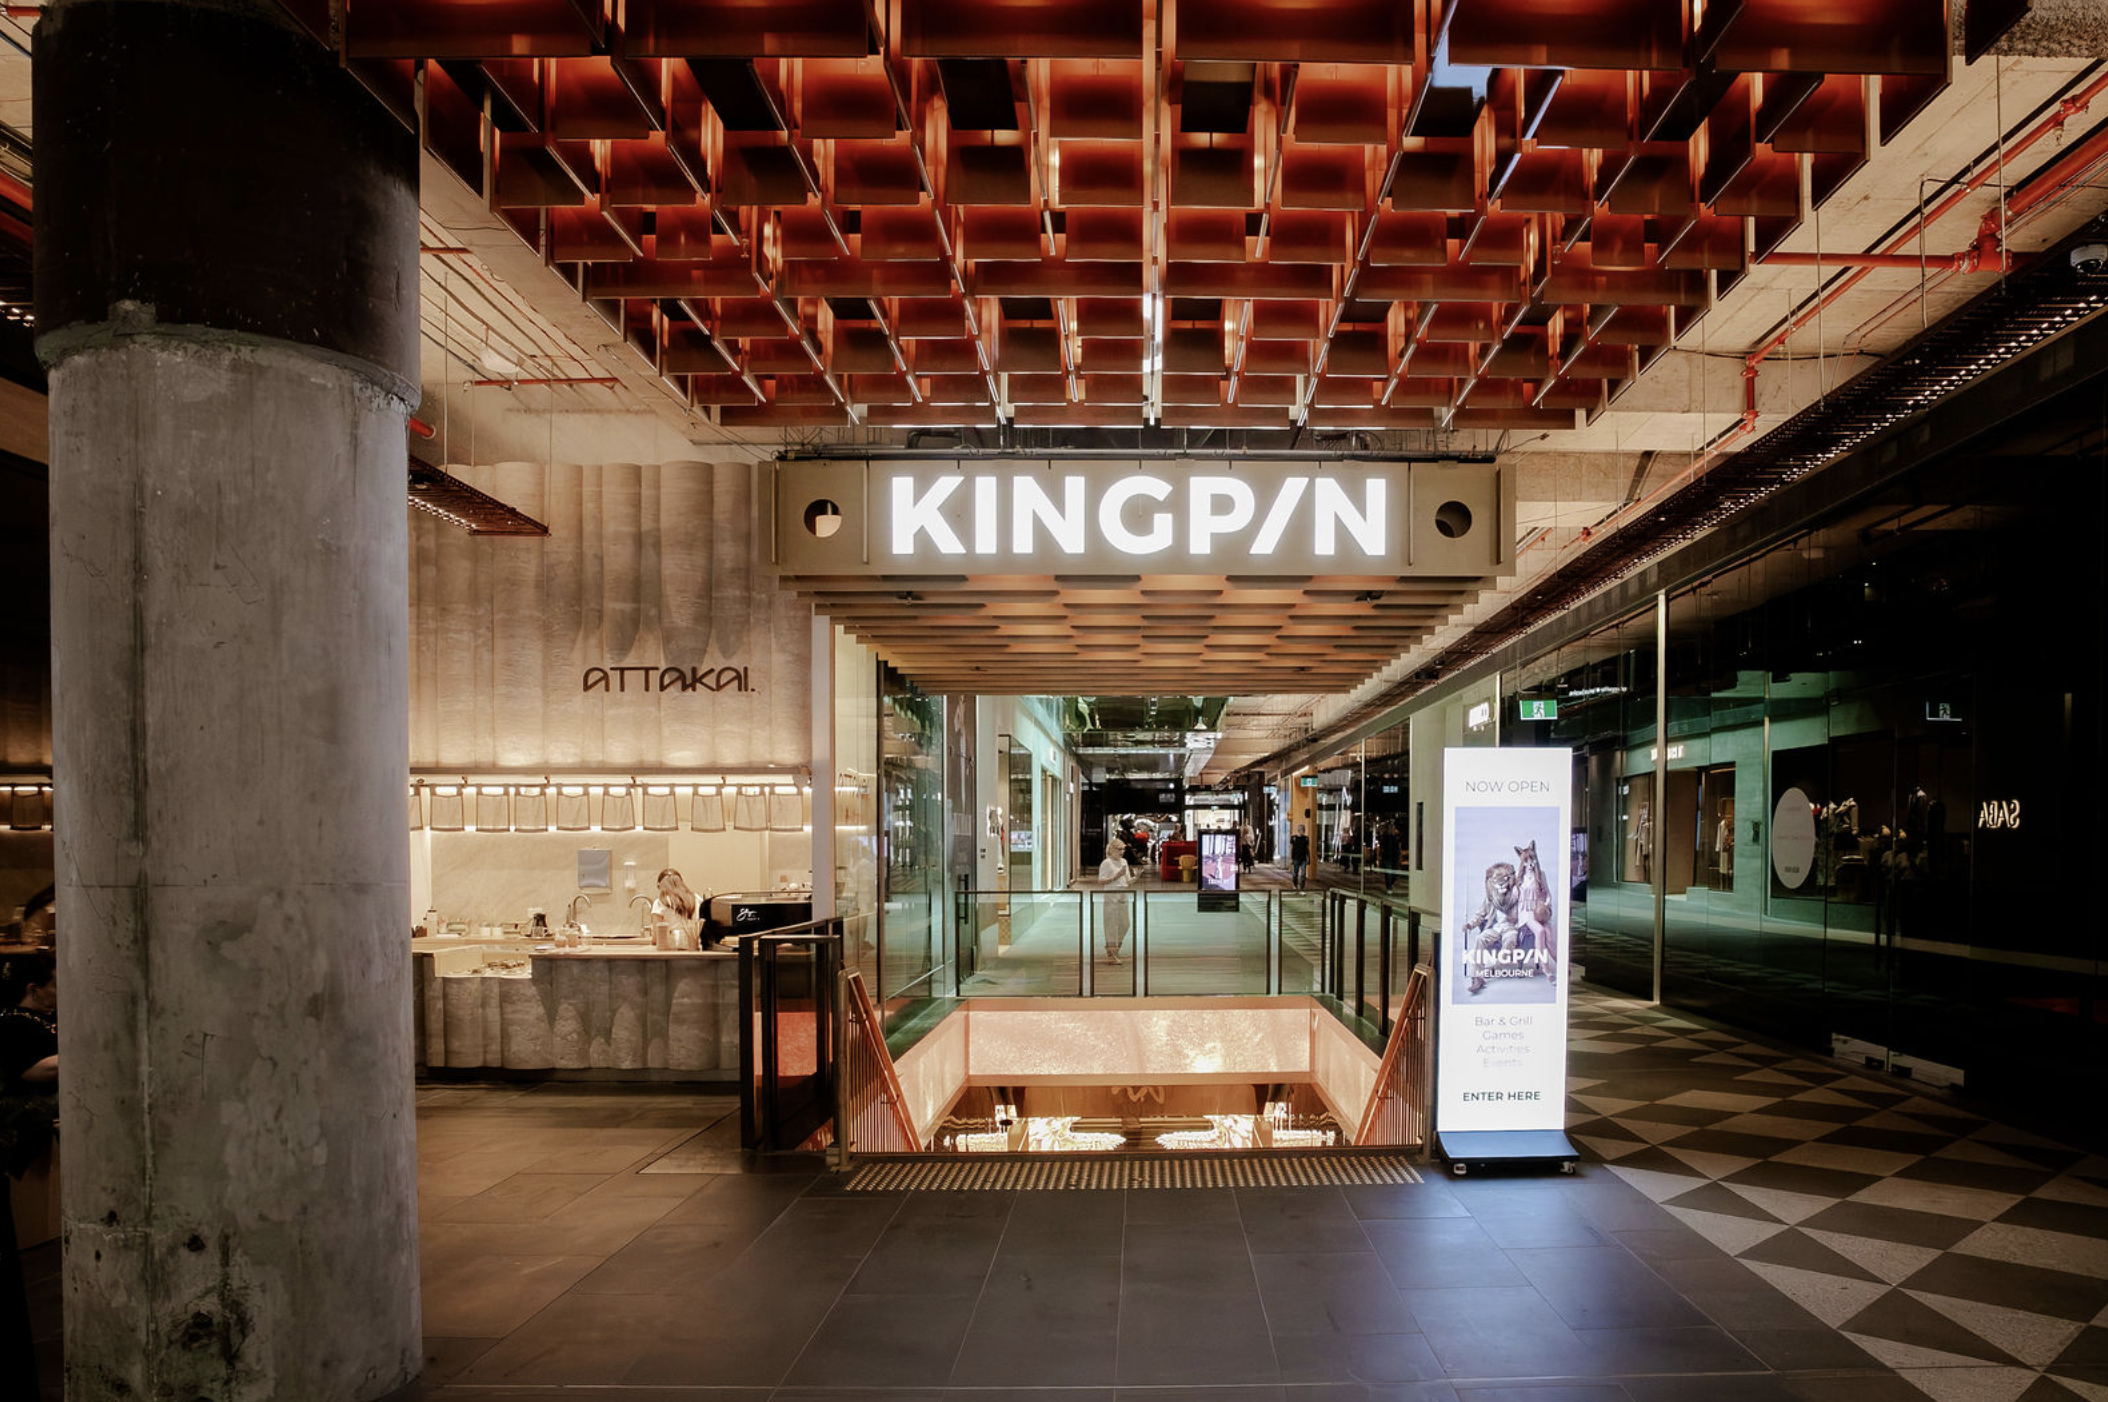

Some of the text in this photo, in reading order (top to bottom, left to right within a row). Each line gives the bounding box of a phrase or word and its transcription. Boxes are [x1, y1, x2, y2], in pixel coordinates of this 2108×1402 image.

[1465, 780, 1550, 793] NOW OPEN
[1475, 968, 1534, 978] MELBOURNE
[1475, 1015, 1533, 1026] Bar & Grill
[1482, 1030, 1525, 1040] Games
[1463, 1091, 1541, 1102] ENTER HERE
